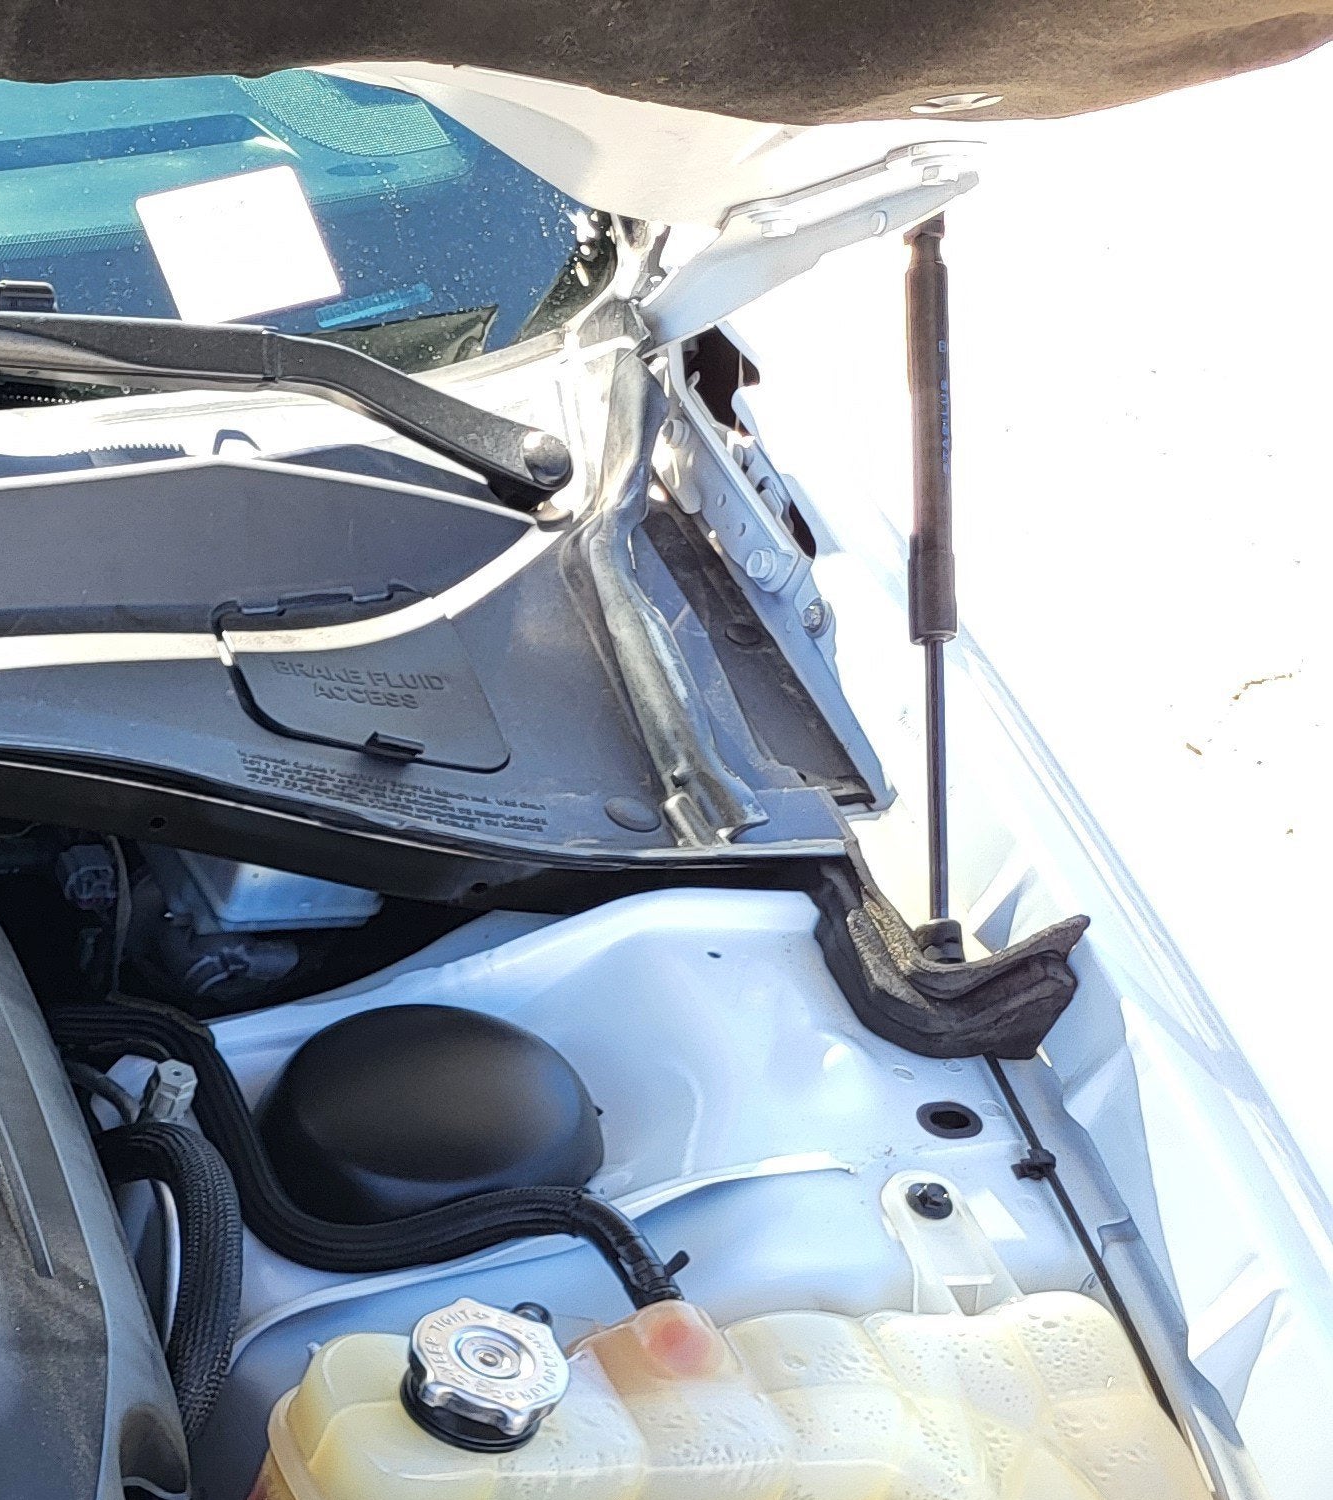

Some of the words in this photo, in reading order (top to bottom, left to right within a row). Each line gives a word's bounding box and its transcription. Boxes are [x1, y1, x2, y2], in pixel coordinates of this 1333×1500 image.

[271, 659, 365, 686] BRAKE
[368, 670, 445, 691] FLUID
[313, 682, 419, 709] ACCESS
